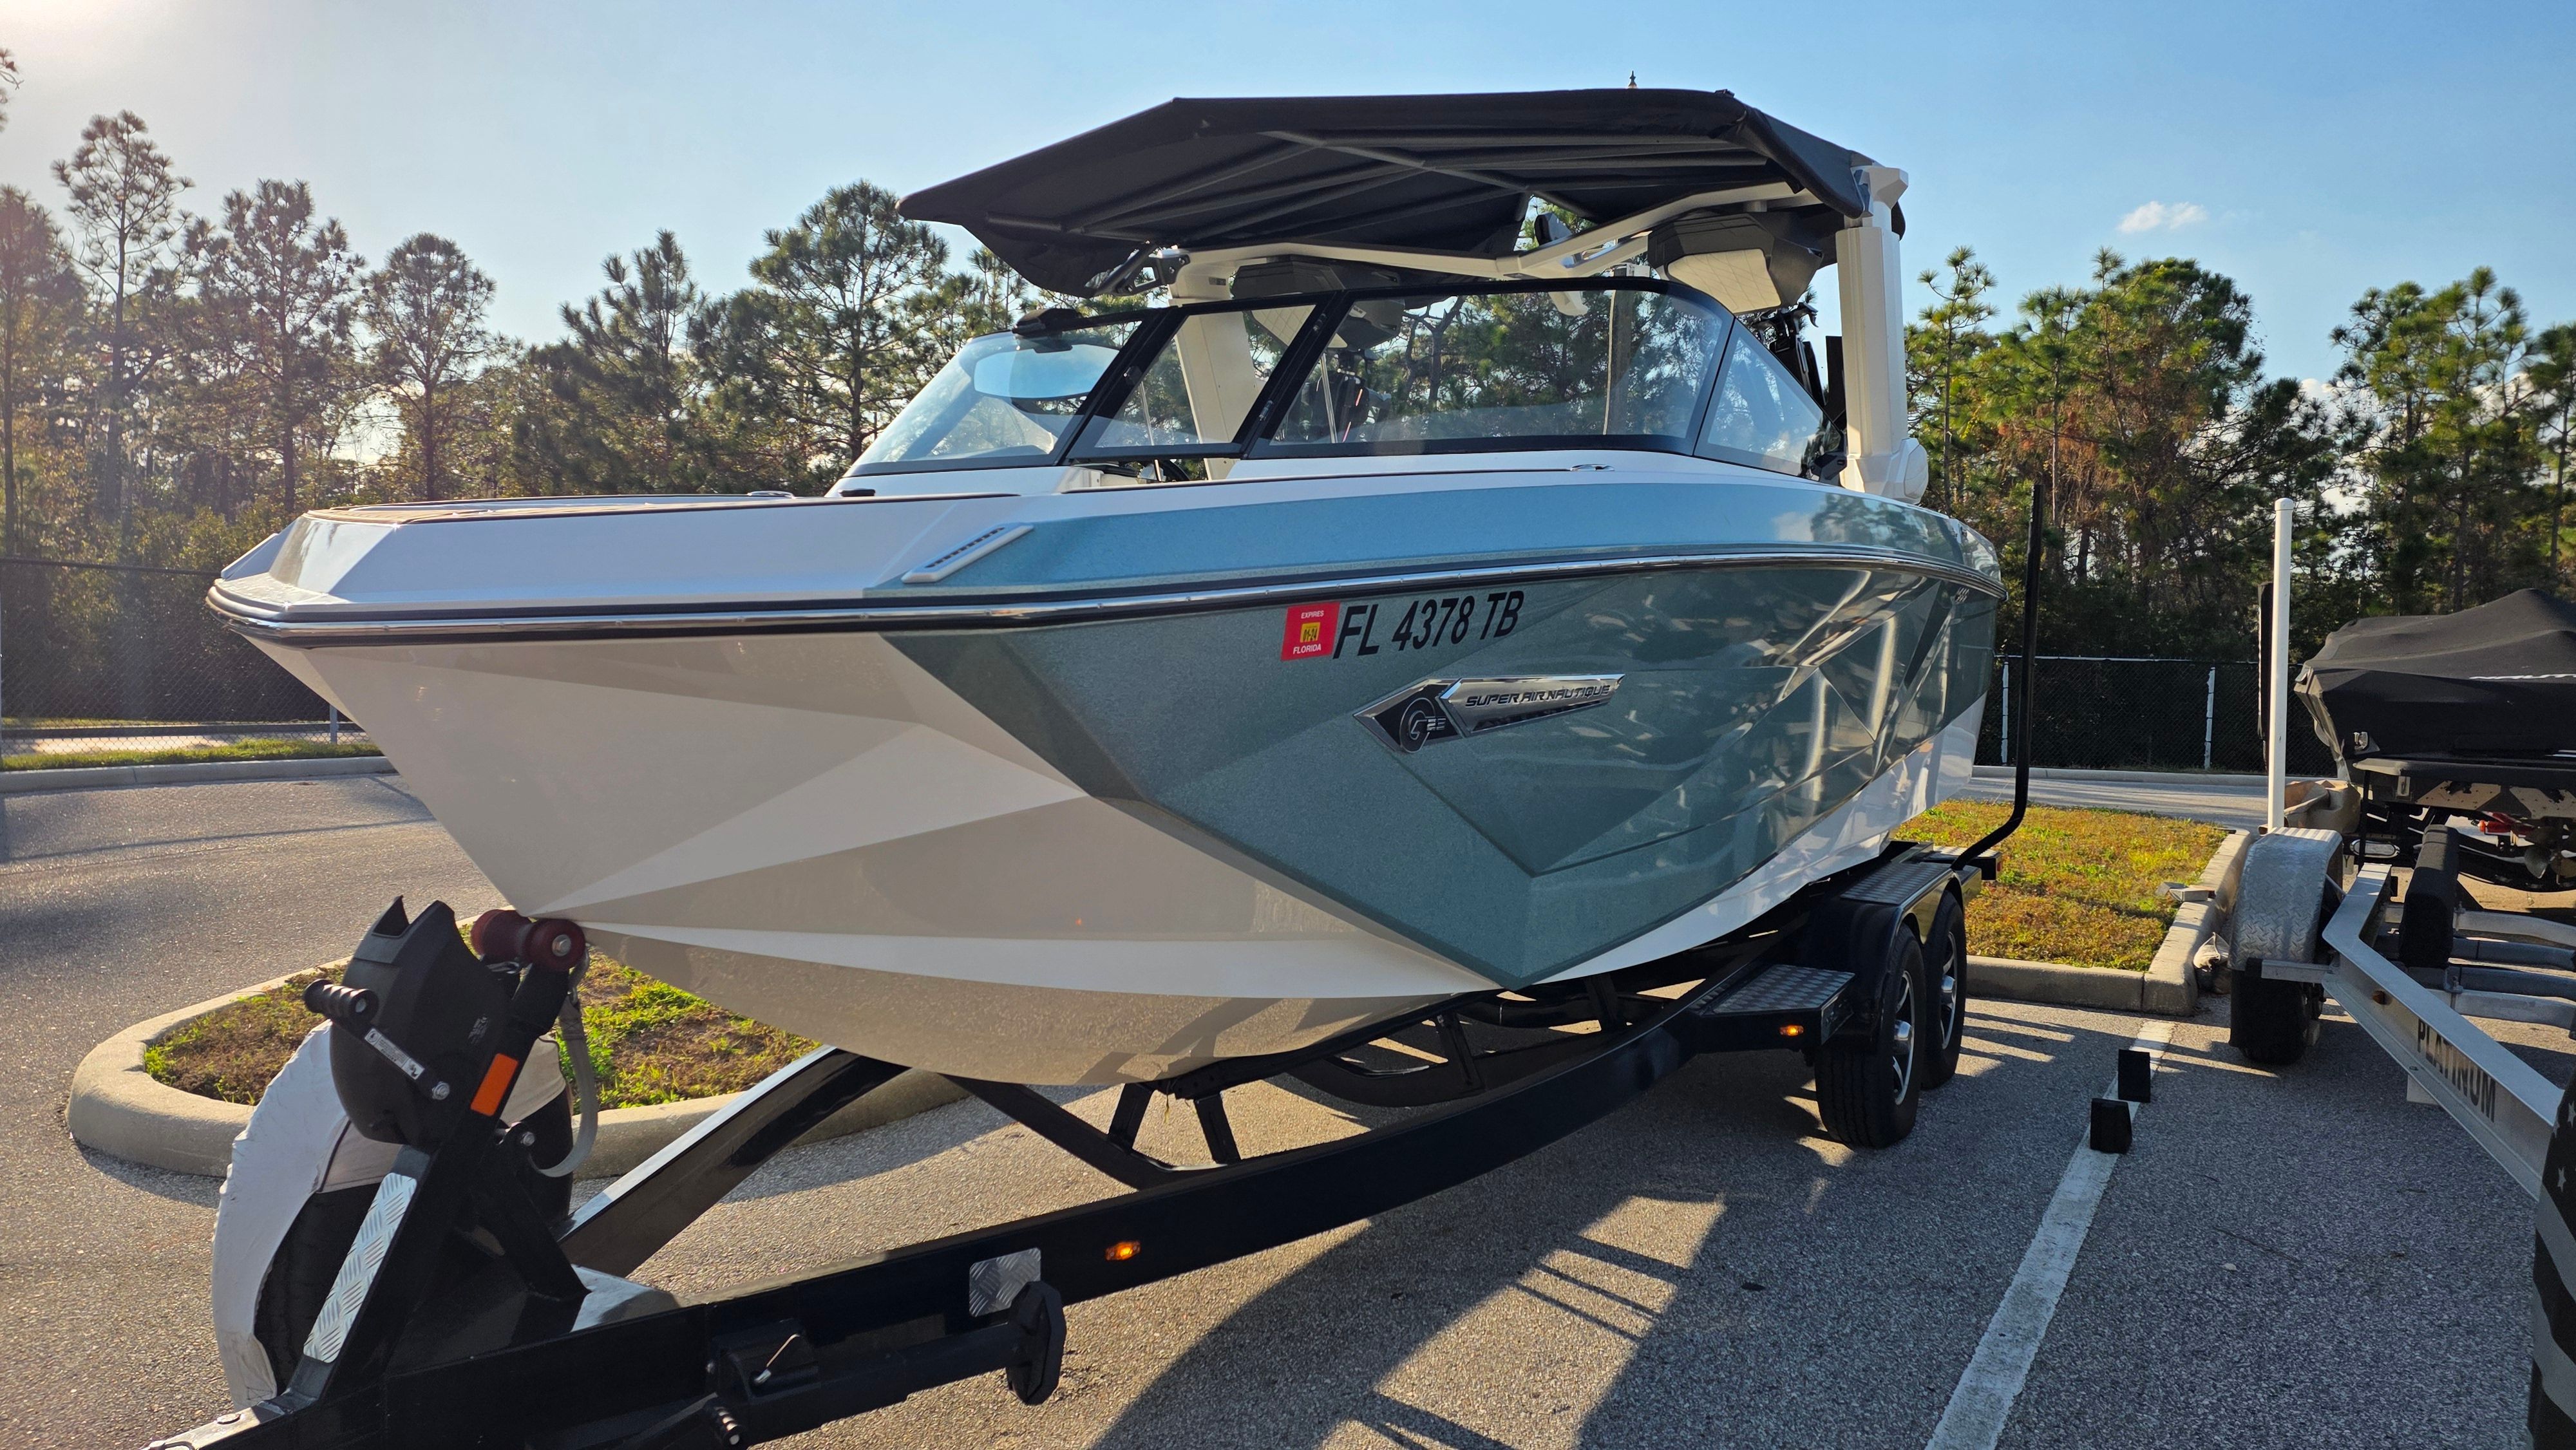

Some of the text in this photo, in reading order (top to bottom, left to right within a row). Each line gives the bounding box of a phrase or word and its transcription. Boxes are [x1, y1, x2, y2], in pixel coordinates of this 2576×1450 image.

[1301, 610, 1325, 619] EXPIRES
[1332, 590, 1525, 660] FL 4378 TB
[1293, 643, 1322, 655] FLORIDA
[1465, 684, 1611, 707] SUPER AIR NAUTIQUE
[2418, 1018, 2496, 1124] PLATINUM
